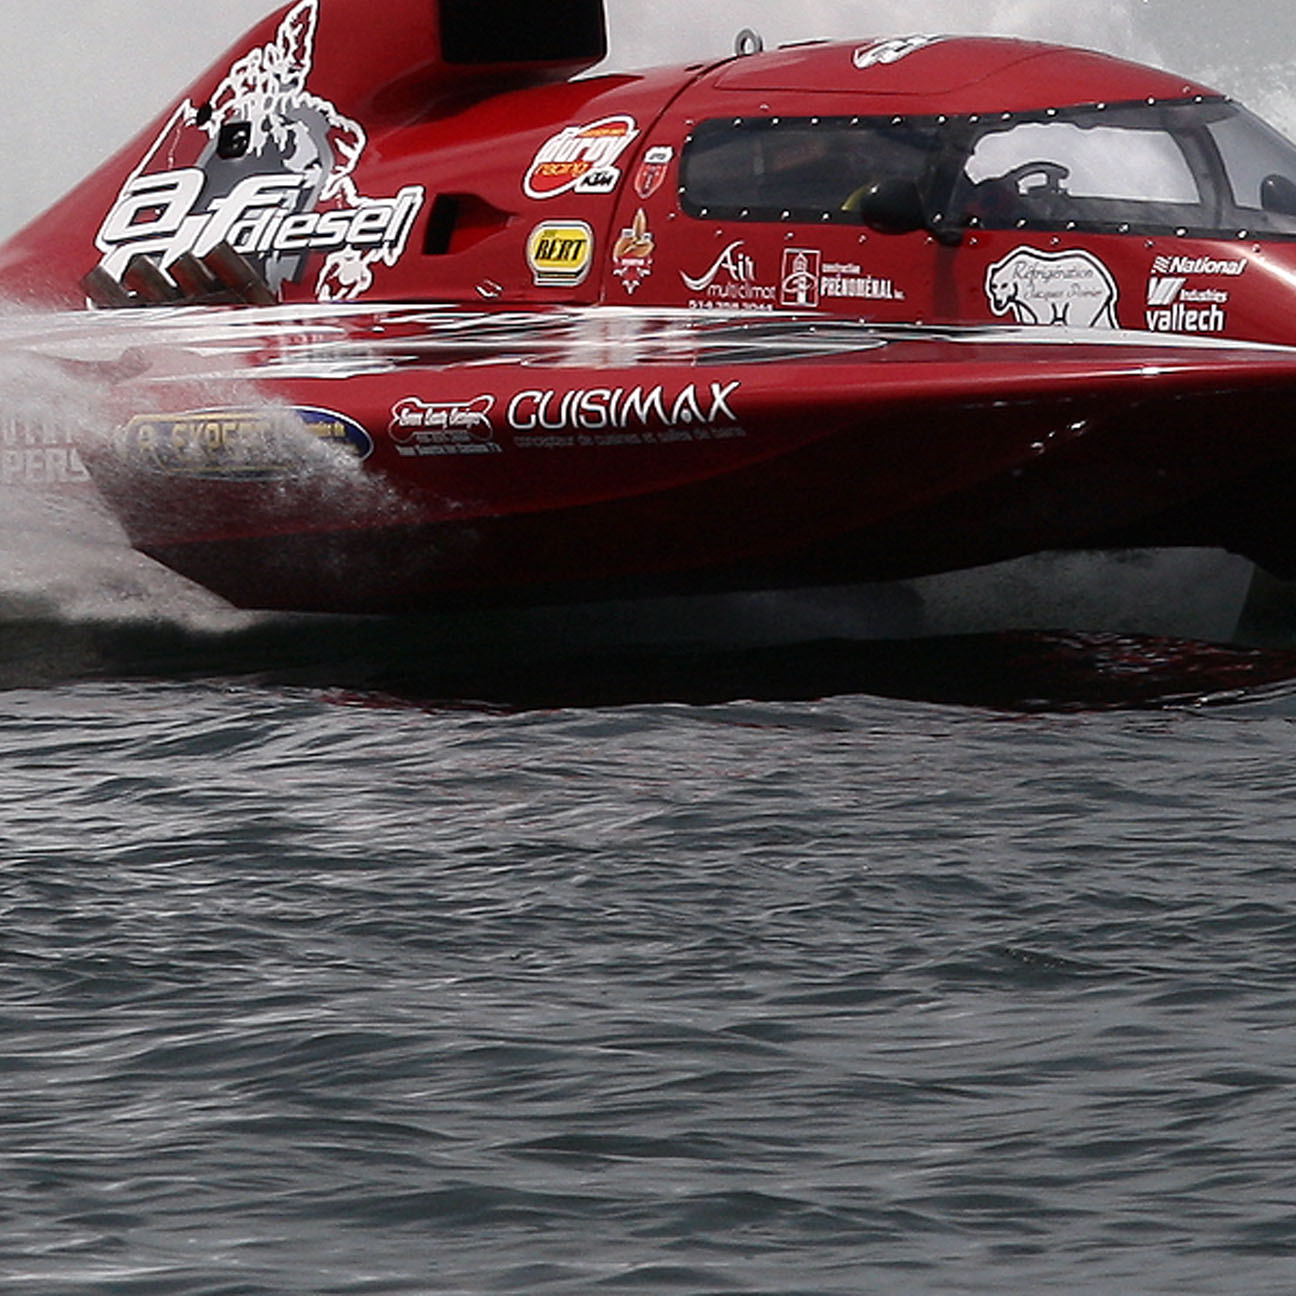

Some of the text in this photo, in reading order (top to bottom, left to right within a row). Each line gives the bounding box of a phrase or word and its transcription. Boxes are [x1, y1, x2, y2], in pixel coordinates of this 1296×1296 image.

[580, 171, 614, 186] KTM
[227, 185, 424, 255] diesel
[535, 239, 587, 261] BERT
[1168, 256, 1248, 276] National
[1146, 303, 1224, 332] valtech
[507, 381, 741, 430] CUISIMAX
